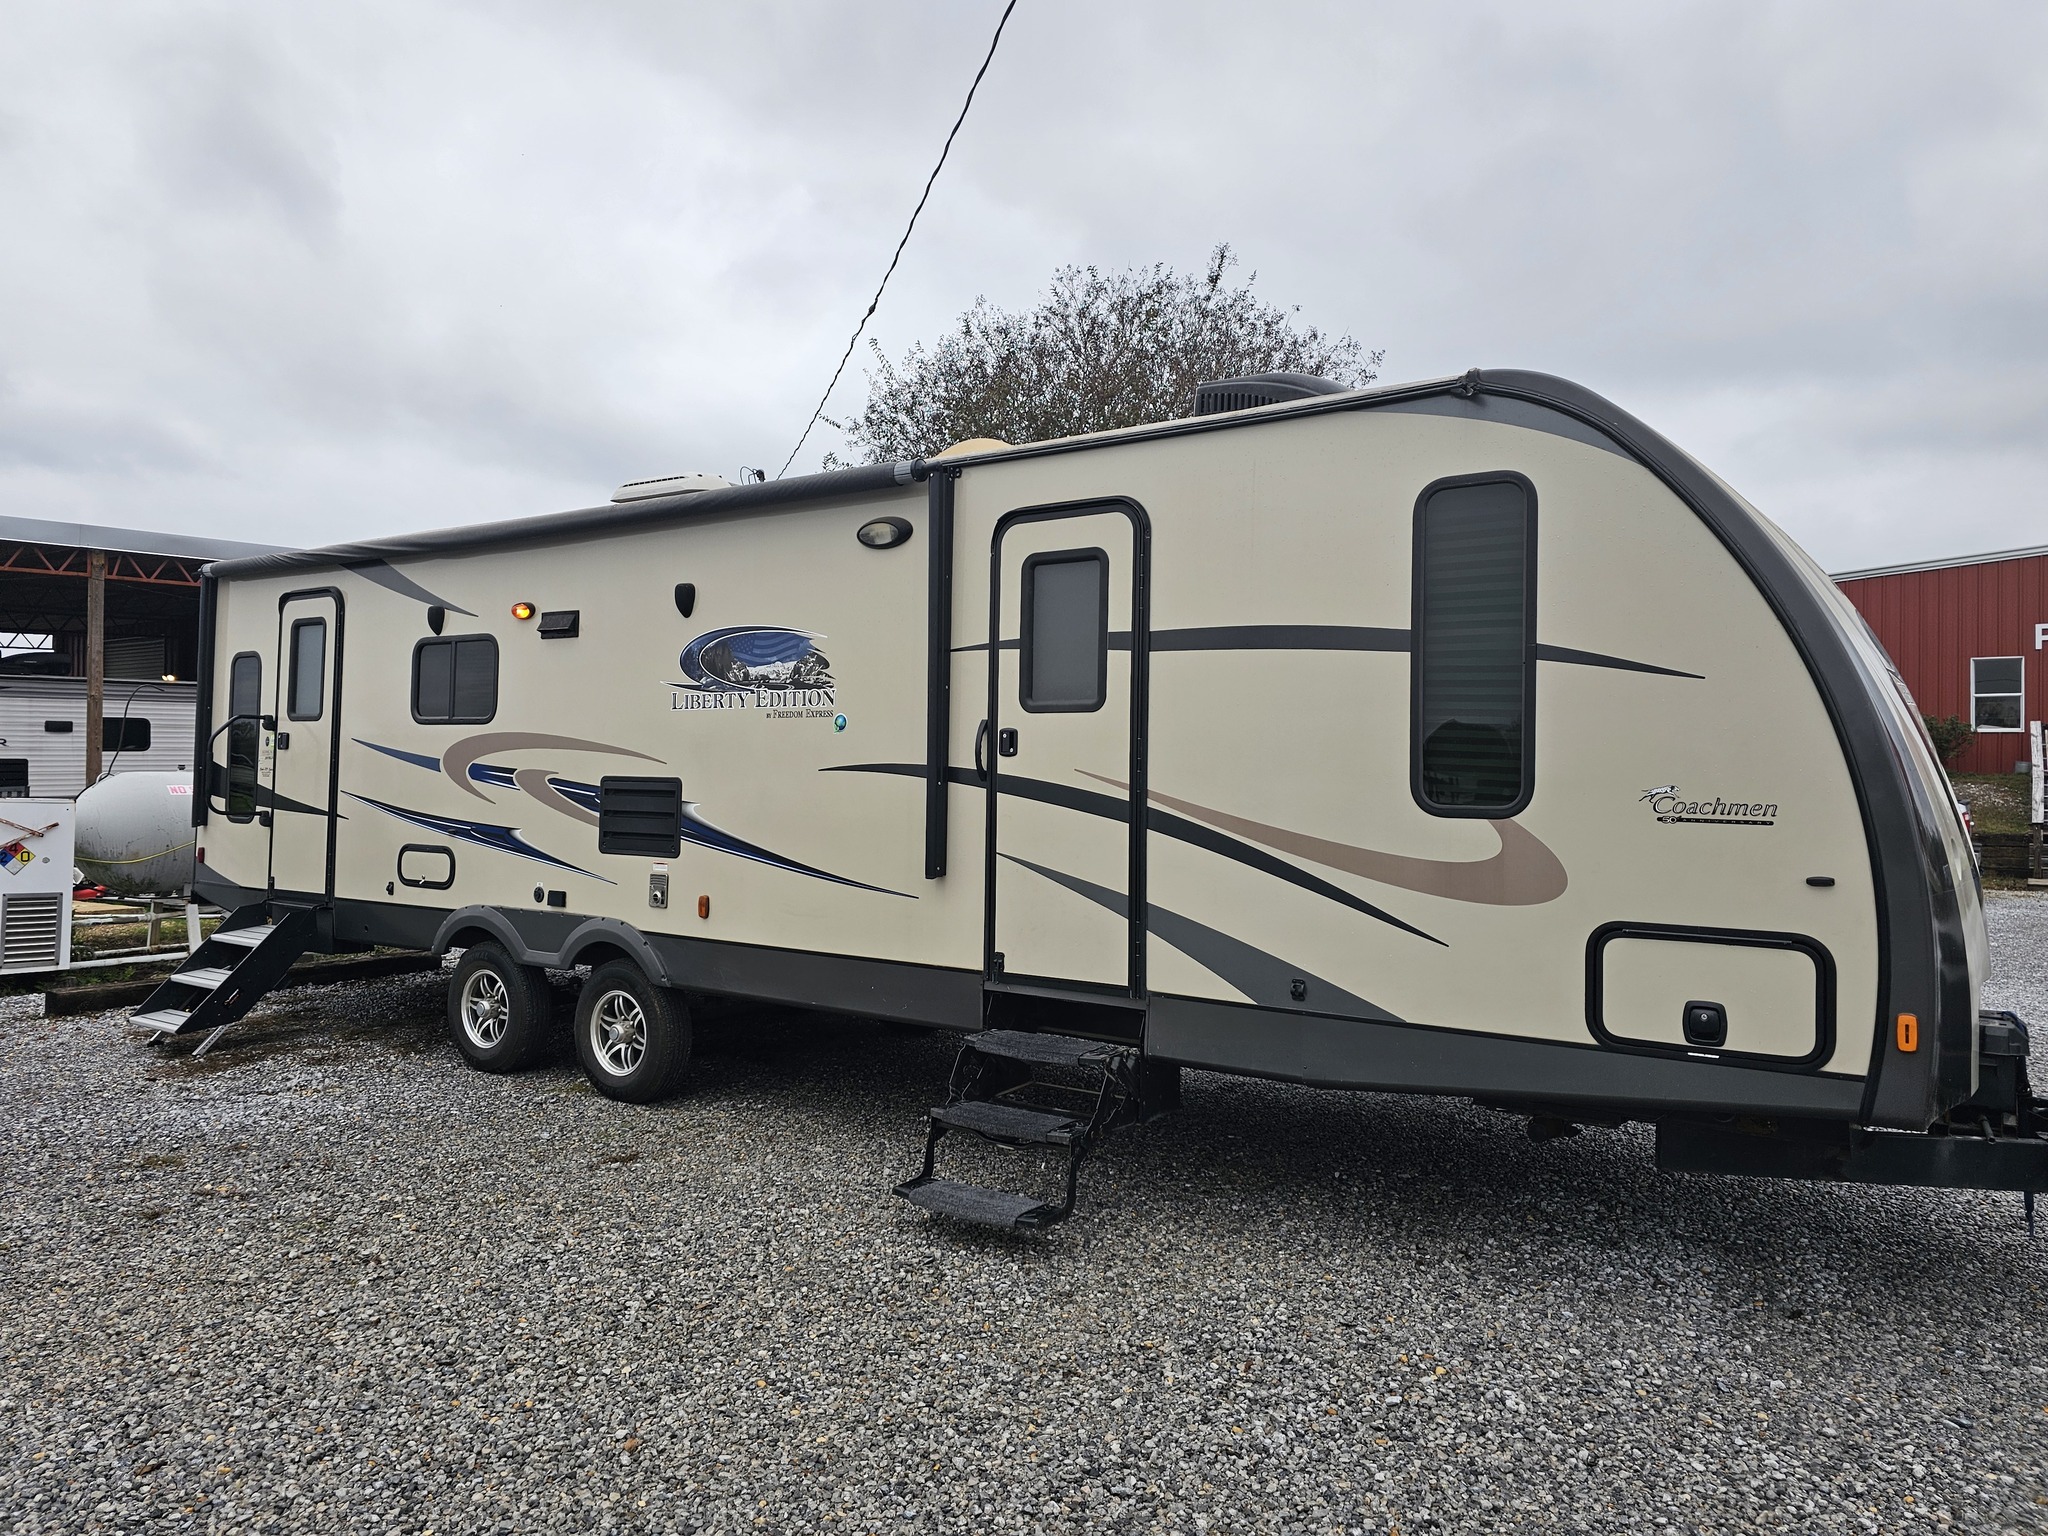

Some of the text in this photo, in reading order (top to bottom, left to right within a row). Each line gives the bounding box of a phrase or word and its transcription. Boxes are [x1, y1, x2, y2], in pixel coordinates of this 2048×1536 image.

[671, 688, 837, 711] LIBERTY EDITION
[773, 709, 803, 719] FREEDOM
[805, 708, 834, 718] EXPRESS
[169, 785, 187, 794] NO
[1653, 796, 1778, 817] Coachmen
[8, 843, 18, 853] 4
[0, 852, 7, 863] 2
